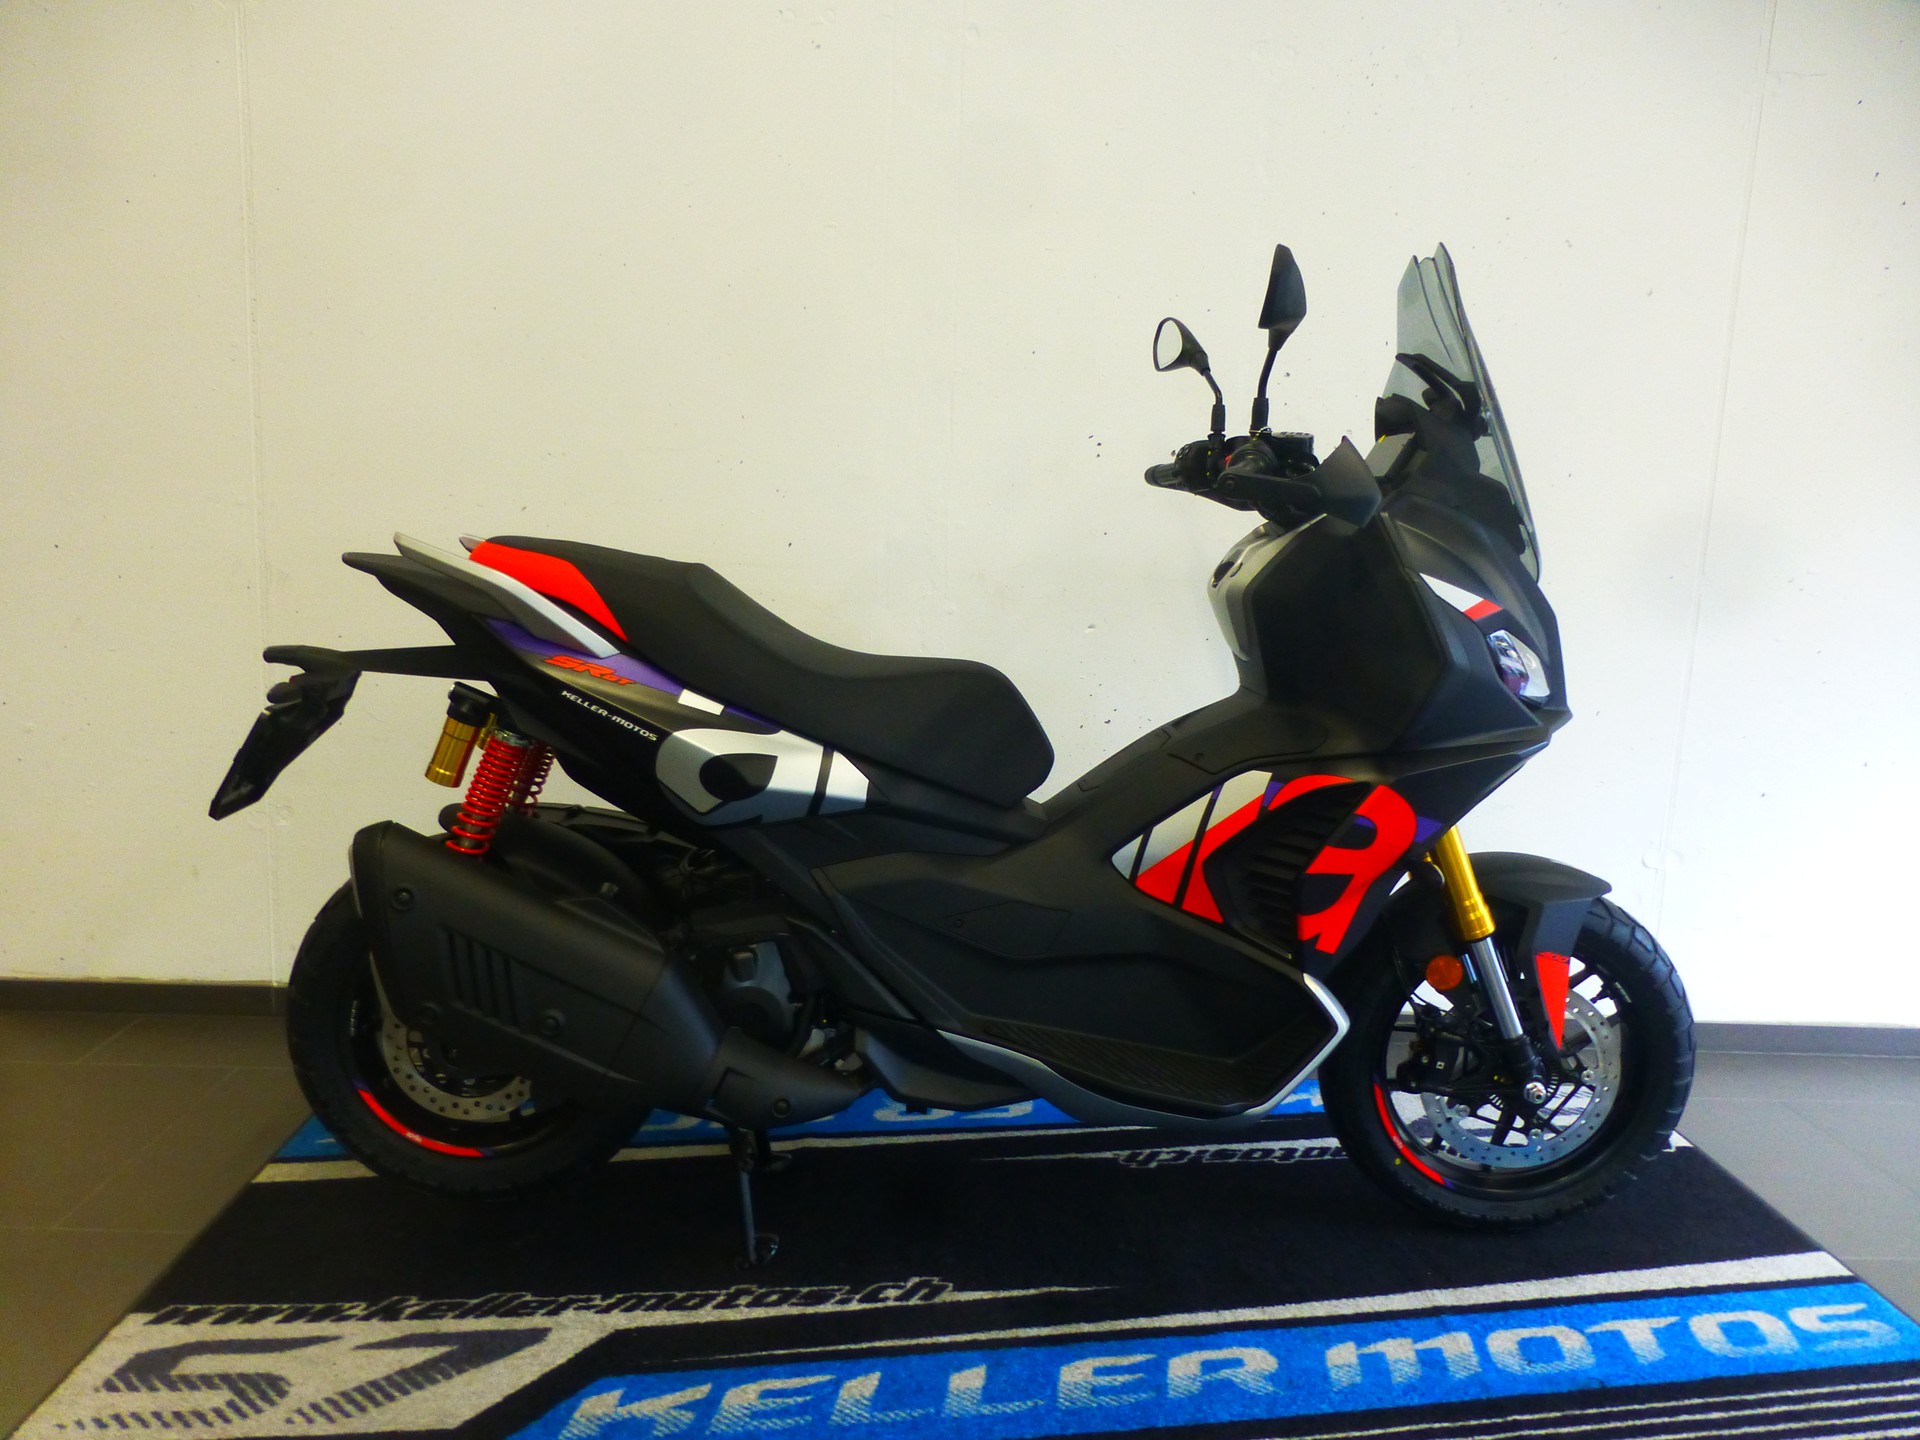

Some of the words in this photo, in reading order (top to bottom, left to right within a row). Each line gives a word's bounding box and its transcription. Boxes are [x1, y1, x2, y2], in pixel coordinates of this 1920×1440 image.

[561, 690, 658, 741] KELLER-MOTOS
[144, 1277, 954, 1325] www.keller-motos.ch
[556, 1346, 1284, 1440] KELLER
[1324, 1303, 1900, 1392] MOTOS
